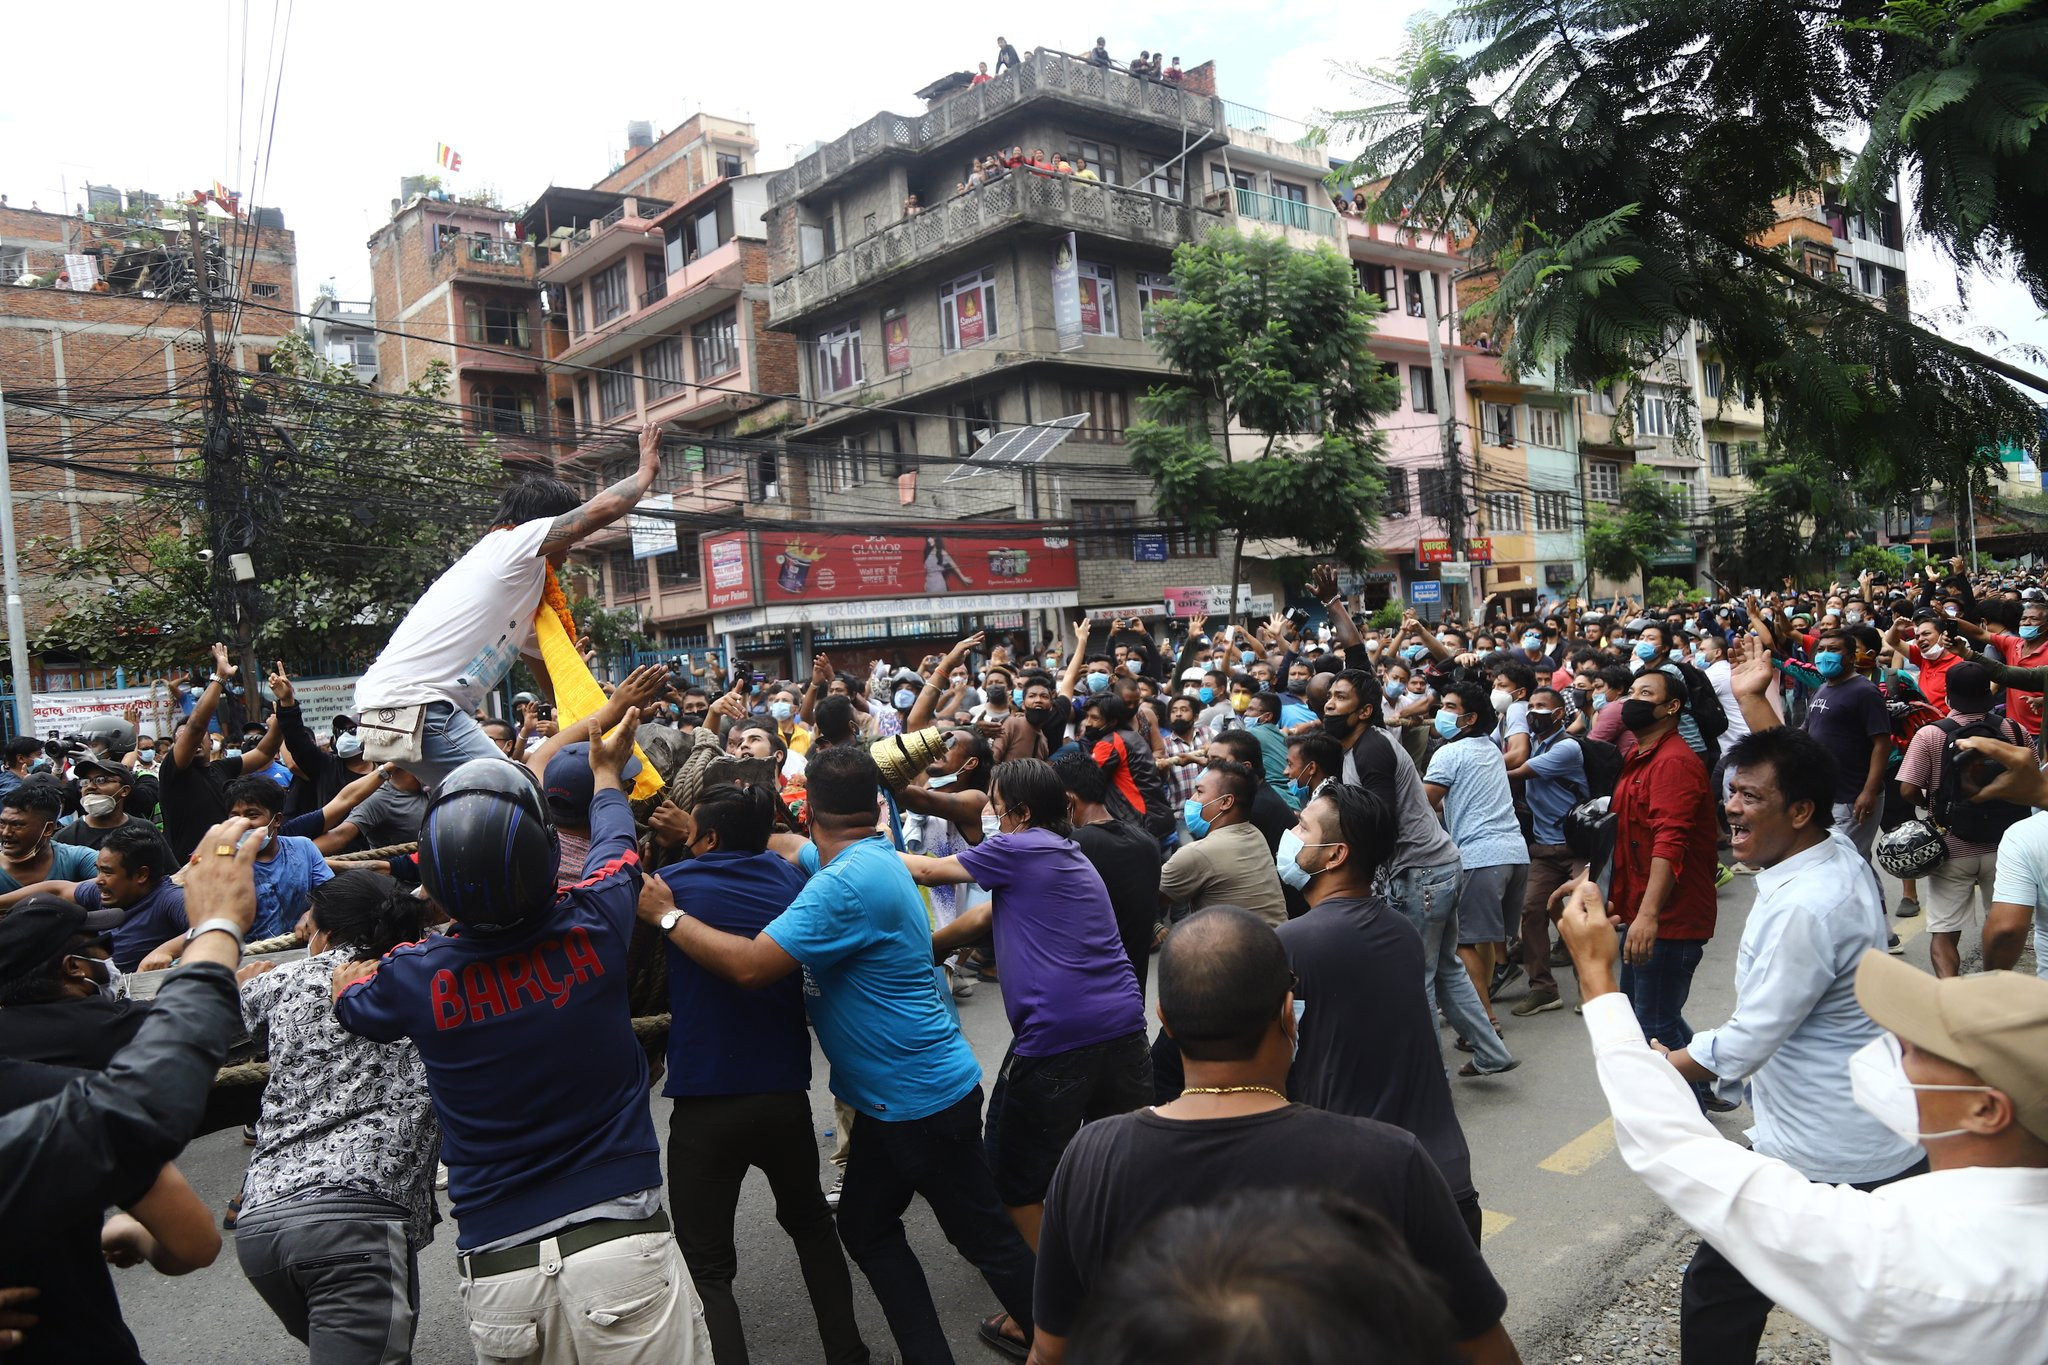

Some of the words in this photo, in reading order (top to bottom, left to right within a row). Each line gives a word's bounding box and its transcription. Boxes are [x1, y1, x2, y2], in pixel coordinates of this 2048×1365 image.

[851, 543, 902, 555] GLAMOR
[712, 593, 730, 605] Berger
[730, 590, 748, 601] Paints
